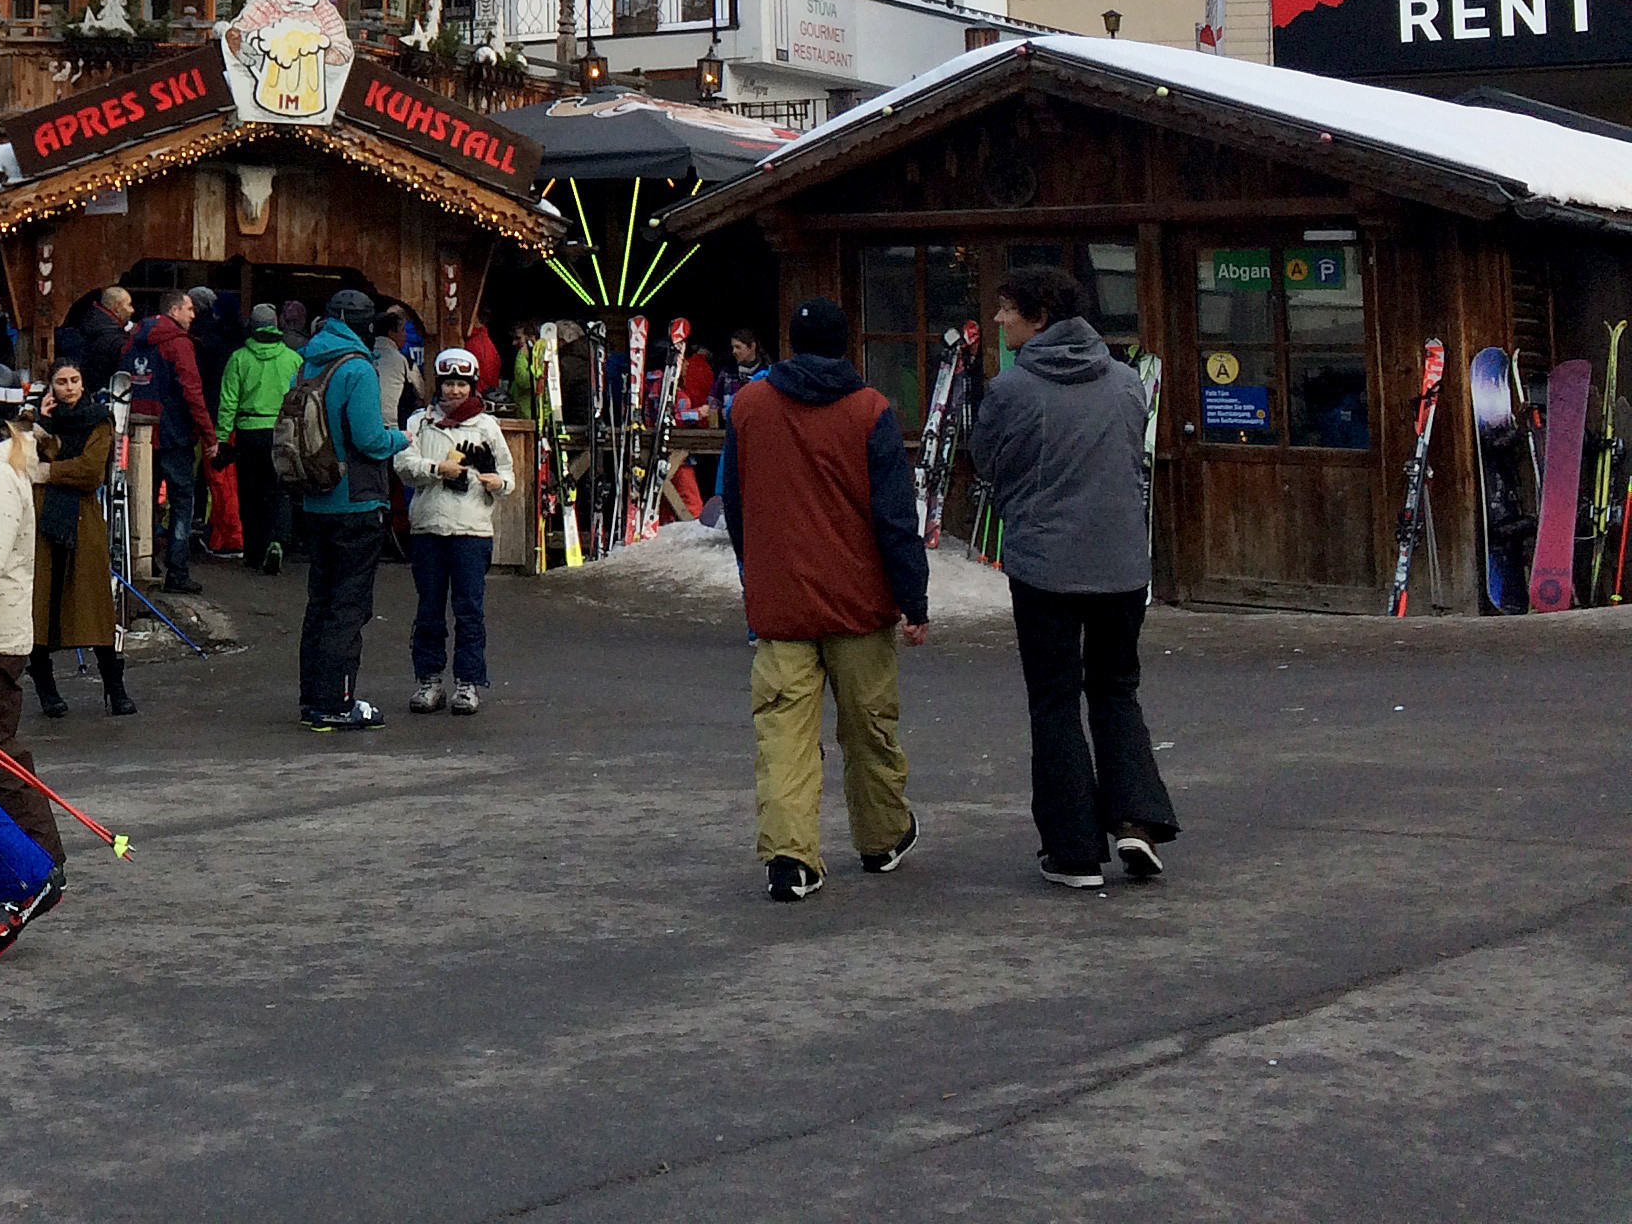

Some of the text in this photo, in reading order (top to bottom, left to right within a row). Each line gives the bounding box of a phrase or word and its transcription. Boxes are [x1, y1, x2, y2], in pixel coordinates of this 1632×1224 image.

[799, 20, 845, 44] GOURMET
[793, 42, 853, 69] RESTAURANT
[33, 67, 207, 158] APRES SKI
[278, 93, 300, 111] IM
[364, 79, 516, 175] KUHSTALL
[1218, 263, 1271, 281] Abgan
[1320, 264, 1335, 282] P
[1216, 363, 1231, 379] A
